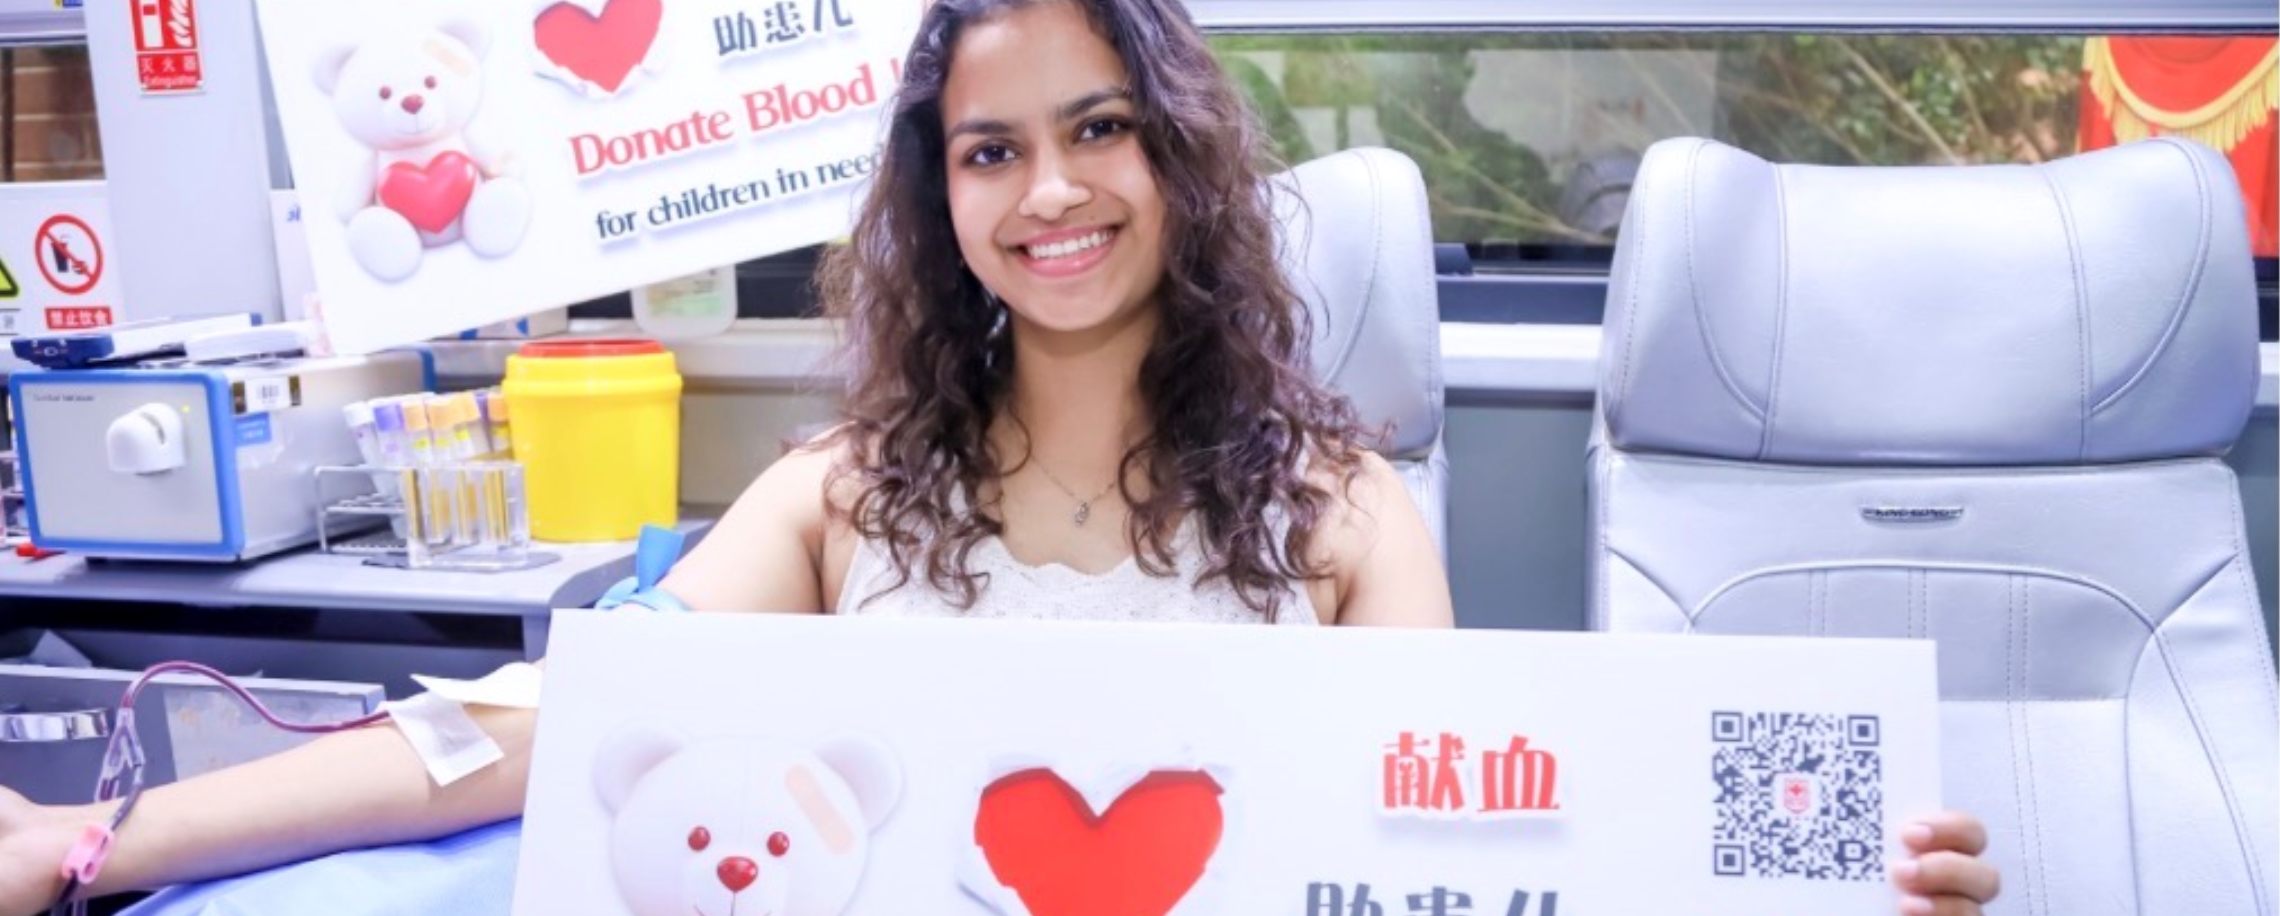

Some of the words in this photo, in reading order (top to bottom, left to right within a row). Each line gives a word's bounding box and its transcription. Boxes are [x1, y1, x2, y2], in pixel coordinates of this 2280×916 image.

[569, 110, 734, 175] Donate
[742, 63, 876, 132] Blood
[596, 211, 637, 239] for
[648, 176, 770, 227] children
[777, 168, 809, 195] in
[1383, 731, 1559, 813] 献血
